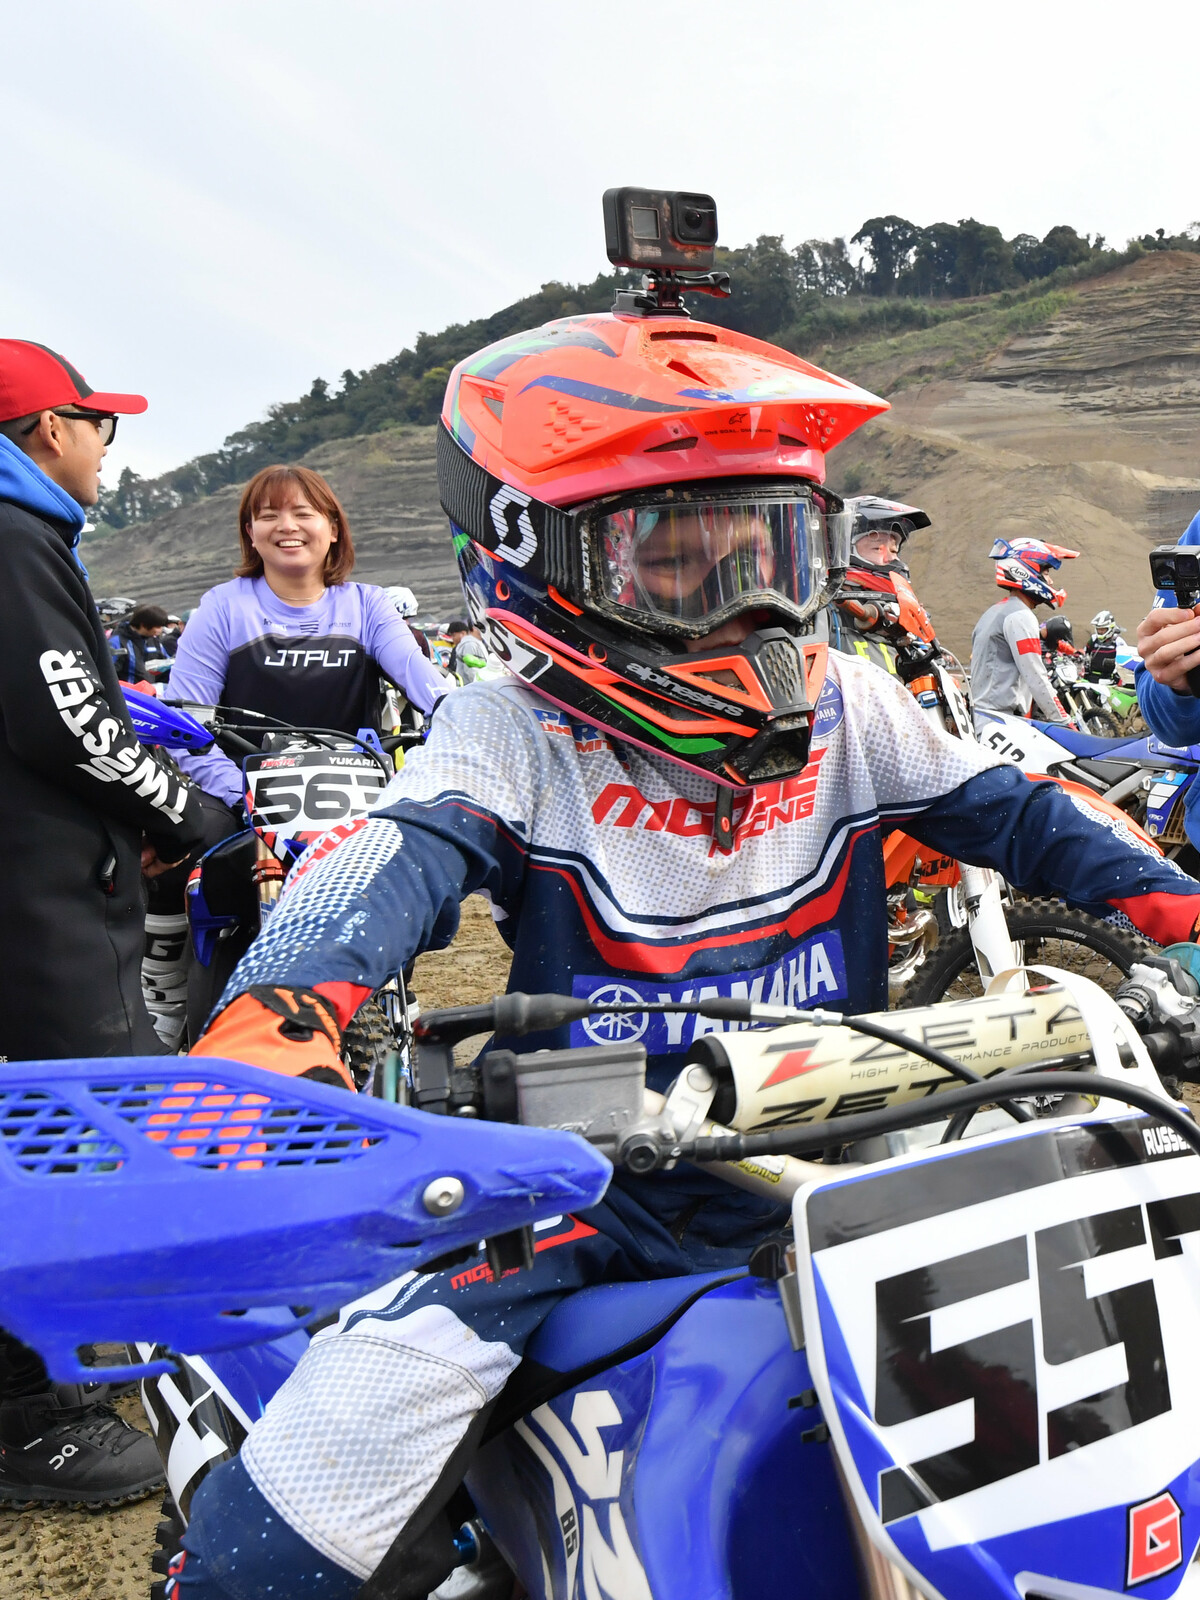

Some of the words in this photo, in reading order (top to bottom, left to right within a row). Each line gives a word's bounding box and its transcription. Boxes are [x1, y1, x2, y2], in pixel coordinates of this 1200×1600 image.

[626, 662, 744, 718] alpinestars
[657, 942, 838, 1045] YAMAHA
[850, 1004, 1084, 1065] ZETA
[850, 1067, 889, 1080] HIGH
[1142, 1125, 1191, 1156] RUSSE
[560, 1506, 578, 1559] 85
